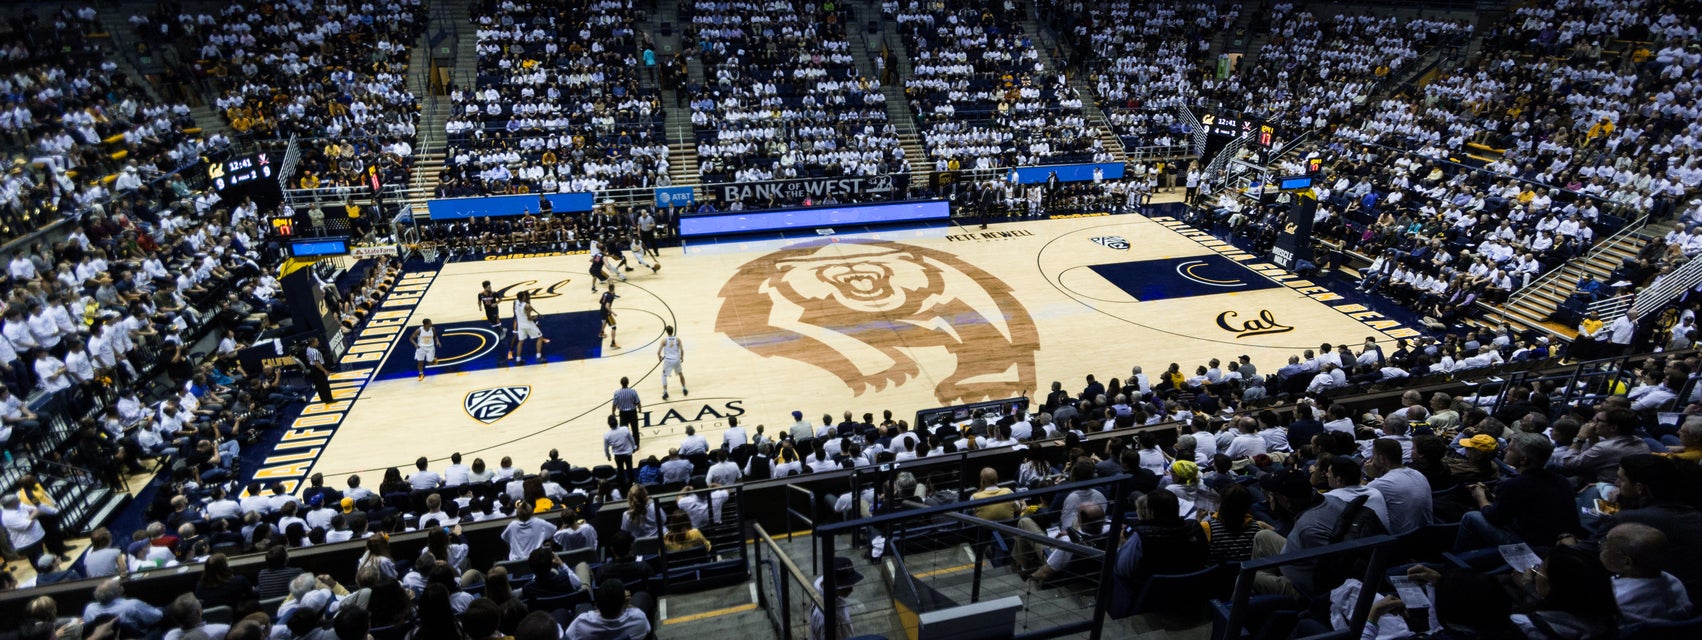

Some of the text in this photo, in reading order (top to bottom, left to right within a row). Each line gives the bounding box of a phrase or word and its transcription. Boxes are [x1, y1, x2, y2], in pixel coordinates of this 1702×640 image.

[1202, 114, 1215, 125] Cal
[1218, 118, 1236, 127] 12:41
[208, 163, 225, 179] Cal
[228, 158, 252, 172] 12:41
[263, 165, 271, 177] 9
[671, 192, 691, 201] AT&T
[725, 178, 864, 201] BANK OF THE WEST
[945, 234, 977, 243] PETE
[980, 229, 1035, 240] NEWELL
[1272, 246, 1293, 260] MUSCLE
[1273, 255, 1288, 267] MILK
[1216, 309, 1294, 338] Cal
[465, 386, 530, 411] PAC
[480, 404, 508, 418] 12
